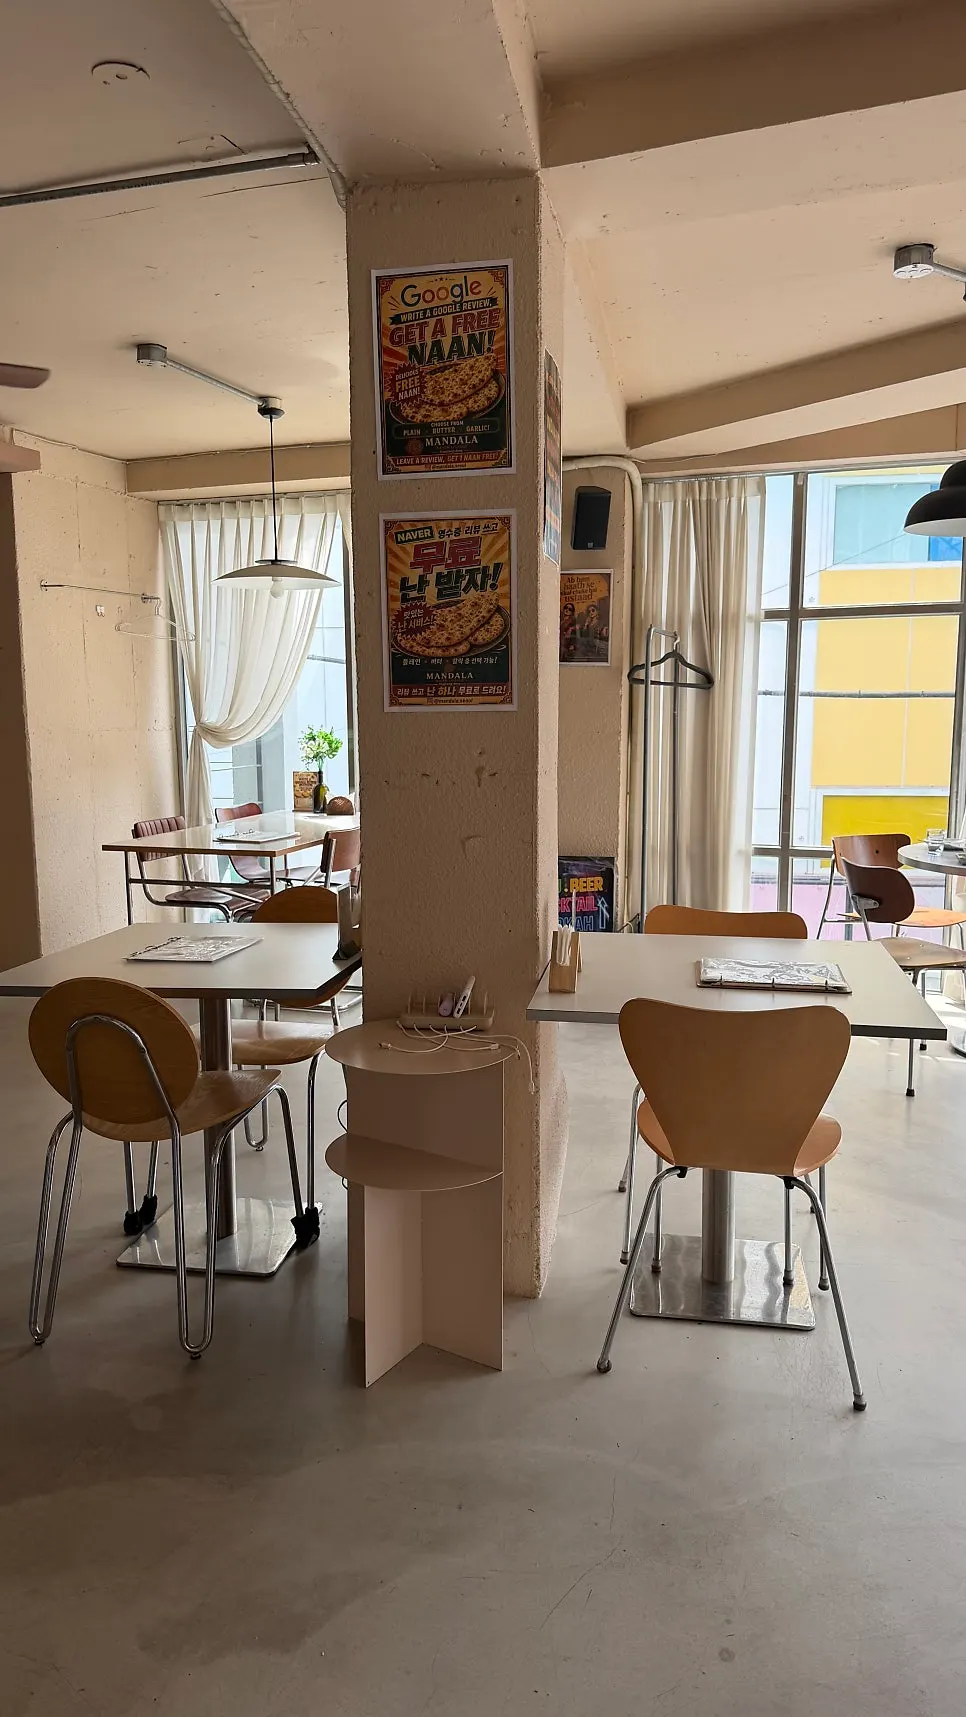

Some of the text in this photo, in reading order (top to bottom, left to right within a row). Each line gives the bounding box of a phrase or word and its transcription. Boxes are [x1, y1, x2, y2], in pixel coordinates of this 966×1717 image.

[401, 275, 482, 307] Google
[400, 310, 424, 322] WRITE
[425, 309, 431, 318] A
[433, 303, 461, 316] GOOGLE
[389, 308, 501, 347] GET A FREE
[407, 330, 497, 367] NAAN!
[395, 376, 421, 393] FREE
[398, 387, 421, 401] NAAN!
[403, 428, 421, 436] PLAIN
[432, 426, 456, 434] BUTTER
[425, 435, 478, 447] MANDALA
[396, 457, 414, 465] LEAVE
[397, 522, 499, 542] NAVER 영수증 리뷰 쓰고
[409, 536, 482, 575] 무료
[400, 562, 504, 605] 난 받자!
[403, 609, 424, 619] 맛있는
[398, 615, 433, 632] 난 서비스!
[402, 658, 421, 666] 플레인
[471, 657, 482, 665] 선택
[426, 672, 474, 680] MANDALA
[397, 685, 506, 697] 리뷰 쓰고 난 하나 무료로 드려요!
[570, 877, 603, 892] BEER
